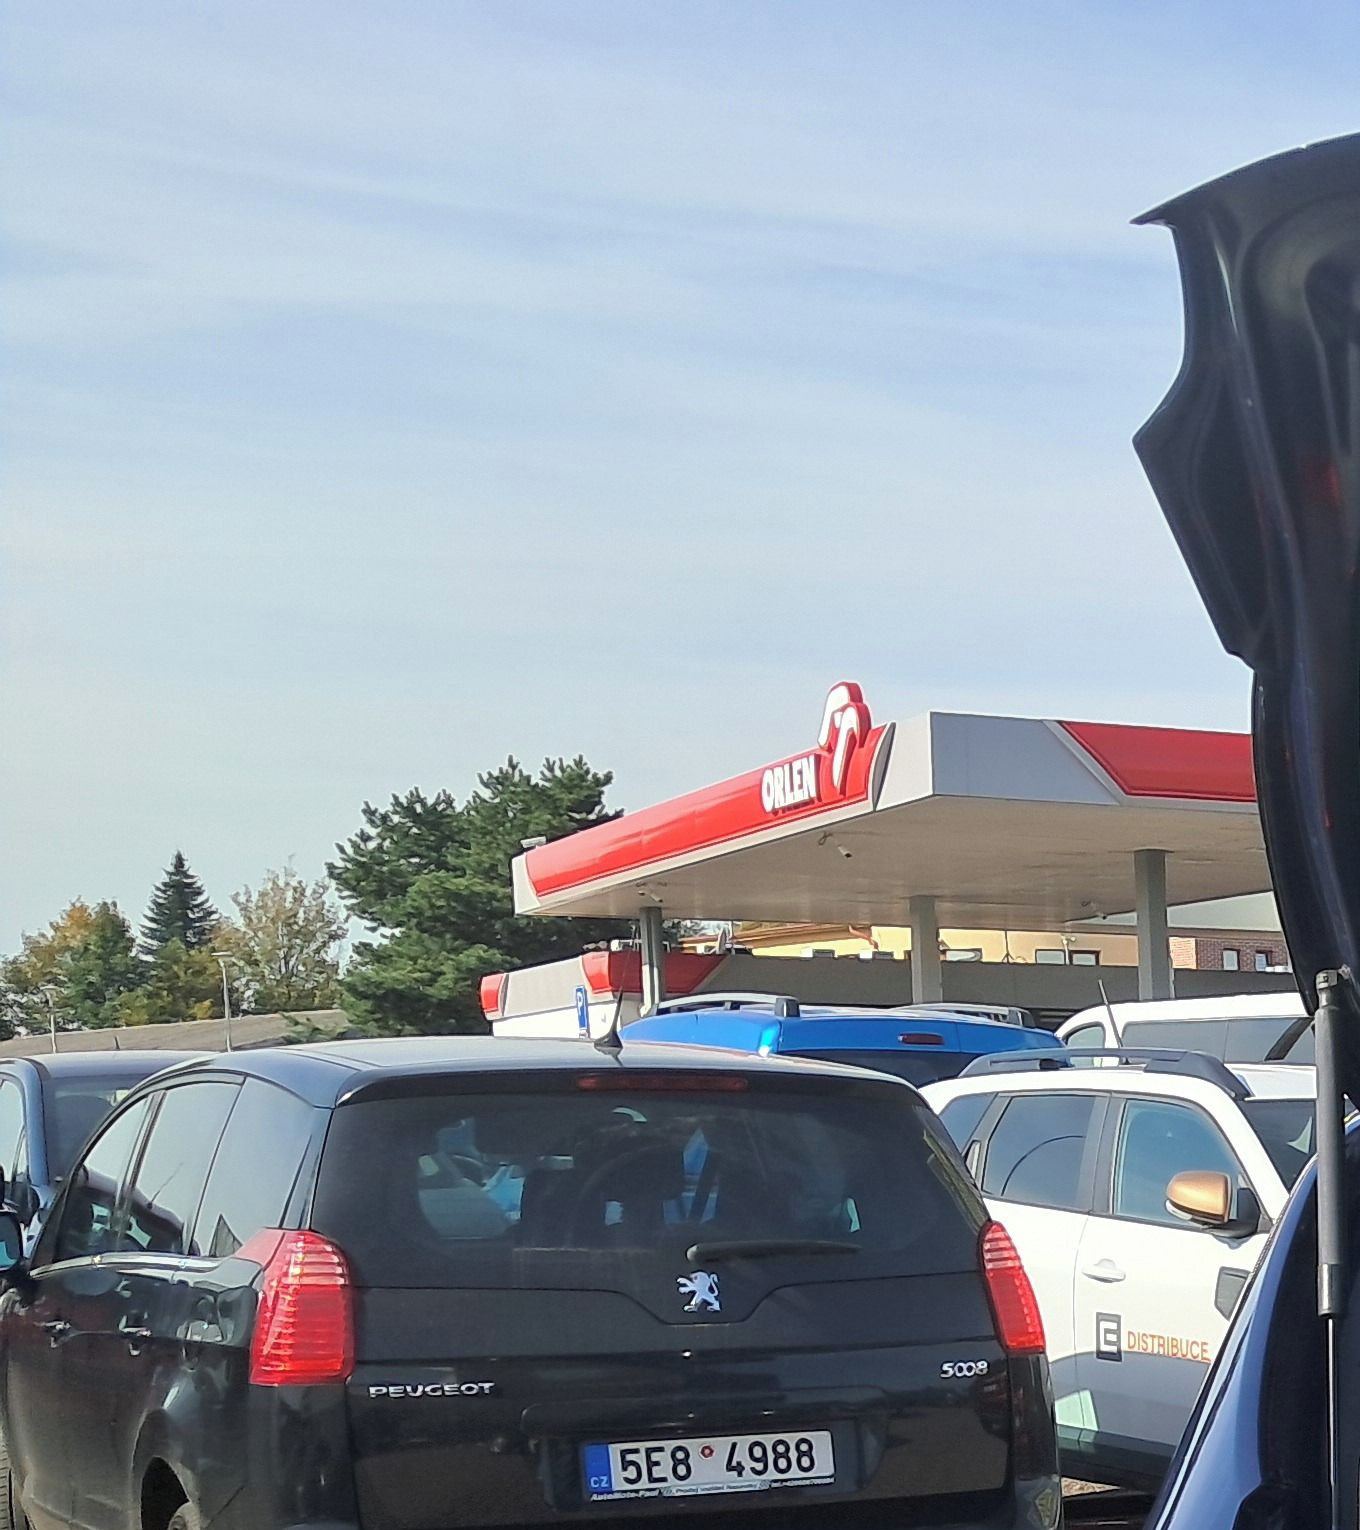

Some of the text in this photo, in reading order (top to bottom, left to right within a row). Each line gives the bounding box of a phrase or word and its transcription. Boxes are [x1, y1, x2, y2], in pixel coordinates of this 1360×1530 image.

[761, 753, 818, 814] ORLEN
[1127, 1330, 1212, 1363] DISTRIBUCE
[939, 1360, 989, 1378] 5008
[368, 1381, 496, 1399] PEUGEOT
[619, 1437, 816, 1486] 5E8 4988
[590, 1476, 609, 1488] CZ
